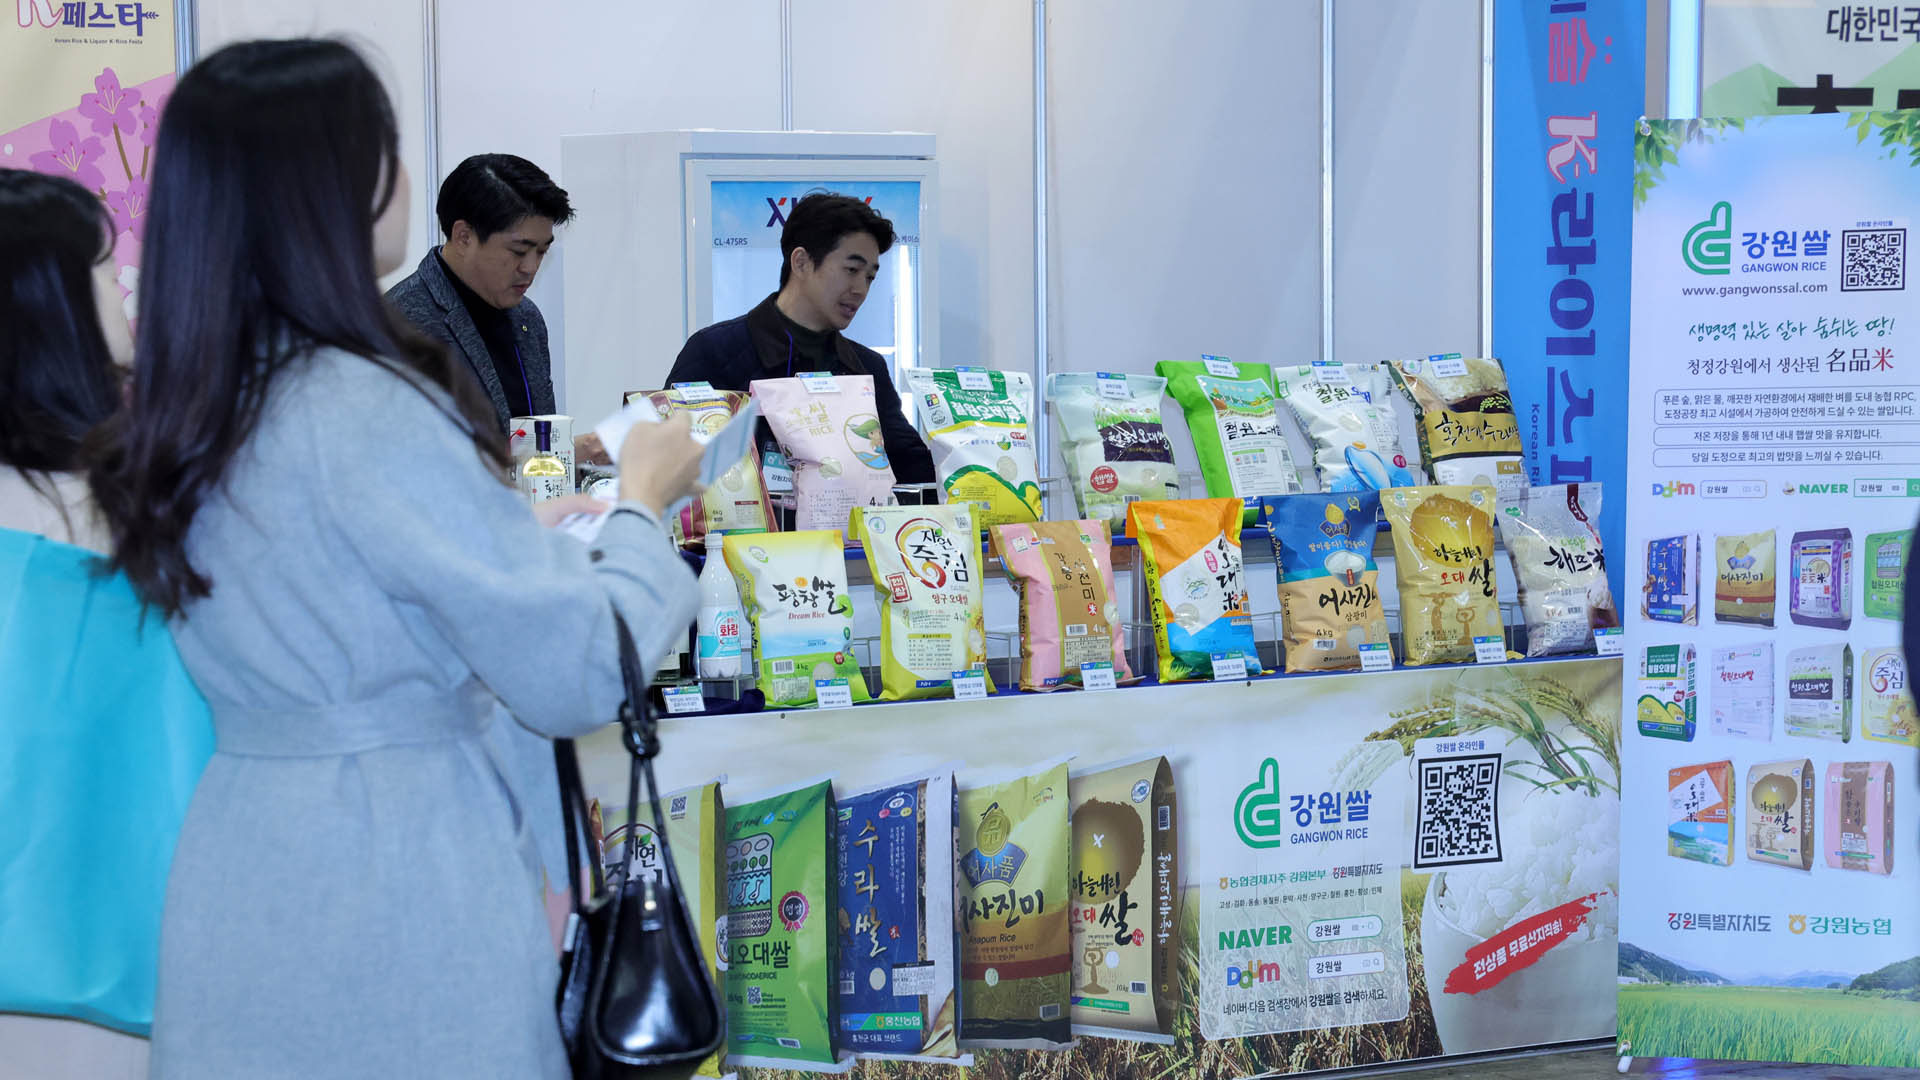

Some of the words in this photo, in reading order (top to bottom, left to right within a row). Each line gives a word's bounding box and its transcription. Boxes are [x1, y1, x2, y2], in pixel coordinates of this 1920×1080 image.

[62, 2, 143, 36] 페스타
[714, 237, 748, 246] CL-475RS
[1741, 230, 1831, 259] 강원쌀
[1741, 262, 1798, 273] GANGWON
[1802, 261, 1827, 271] RICE
[1682, 282, 1828, 298] www.gangwonssal.com
[1689, 322, 1737, 342] 생명력
[1742, 320, 1770, 341] 있는
[1776, 319, 1808, 340] 살아
[1813, 316, 1859, 338] 숨쉬는
[1865, 316, 1896, 337] 땅!
[1687, 358, 1771, 375] 청정강원에서
[1776, 356, 1820, 373] 생산된
[1826, 347, 1895, 373] 名品米
[1663, 395, 1679, 406] 푸른
[1681, 394, 1692, 406] 숲,
[1694, 394, 1711, 405] 맑은
[1727, 393, 1752, 405] 깨끗한
[1754, 392, 1805, 404] 자연환경에서
[1807, 392, 1833, 404] 재배한
[1835, 392, 1852, 403] 벼를
[1854, 391, 1872, 402] 도내
[1874, 391, 1892, 402] 농협
[1893, 391, 1917, 402] RPC,
[1664, 408, 1698, 420] 도정공장
[1700, 408, 1717, 418] 최고
[1719, 407, 1753, 418] 시설에서
[1755, 407, 1790, 418] 가공하여
[1791, 406, 1825, 418] 안전하게
[1827, 406, 1844, 417] 드실
[1846, 406, 1855, 416] 수
[1857, 406, 1875, 416] 있는
[1877, 405, 1914, 416] 쌀입니다.
[1529, 403, 1540, 461] Korean
[1694, 431, 1711, 442] 저온
[1713, 431, 1739, 442] 저장을
[1742, 430, 1759, 441] 통해
[1761, 430, 1773, 441] 1년
[1776, 430, 1793, 440] 내내
[1796, 430, 1813, 441] 햅쌀
[1815, 429, 1833, 440] 맛을
[1835, 429, 1882, 440] 유지합니다.
[1691, 452, 1709, 463] 당일
[1711, 452, 1746, 462] 도정으로
[1748, 452, 1775, 462] 최고의
[1776, 451, 1803, 462] 밥맛을
[1805, 451, 1832, 462] 느끼실
[1834, 451, 1843, 461] 수
[1845, 450, 1883, 461] 있습니다.
[1652, 479, 1695, 499] Daum
[1706, 485, 1728, 495] 강원쌀
[1799, 483, 1849, 494] NAVER
[1860, 484, 1883, 493] 강원쌀
[1432, 543, 1483, 563] 하늘내린
[1440, 571, 1465, 586] 오대
[1468, 558, 1494, 598] 쌀
[772, 575, 848, 615] 평창쌀
[788, 612, 811, 621] Dream
[812, 611, 826, 620] Rice
[1316, 628, 1333, 638] 4kg
[1435, 742, 1457, 753] 강원쌀
[1289, 790, 1372, 828] 강원쌀
[1290, 829, 1343, 845] GANGWON
[1346, 827, 1369, 840] RICE
[1230, 872, 1287, 888] 농협경제지주
[1289, 869, 1327, 881] 강원본부
[1332, 863, 1383, 879] 강원특별자치도
[852, 819, 888, 958] 수라쌀
[1072, 871, 1121, 897] 하늘내린
[1072, 908, 1097, 925] 오대
[1098, 890, 1138, 946] 쌀
[1667, 912, 1772, 932] 강원특별자치도
[1809, 916, 1892, 936] 강원농협
[999, 933, 1017, 943] Rice
[1218, 925, 1292, 951] NAVER
[1315, 924, 1341, 937] 강원쌀
[1473, 946, 1508, 981] 전상품
[1508, 918, 1564, 959] 무료산지직송!
[1226, 959, 1281, 990] Daum
[1315, 961, 1342, 974] 강원쌀
[1223, 1000, 1266, 1016] 네이버·다음
[1267, 996, 1308, 1012] 검색창에서
[1309, 993, 1342, 1008] 강원쌀을
[1343, 988, 1388, 1004] 검색하세요.
[870, 1033, 882, 1043] 대표
[884, 1033, 903, 1044] 브랜드
